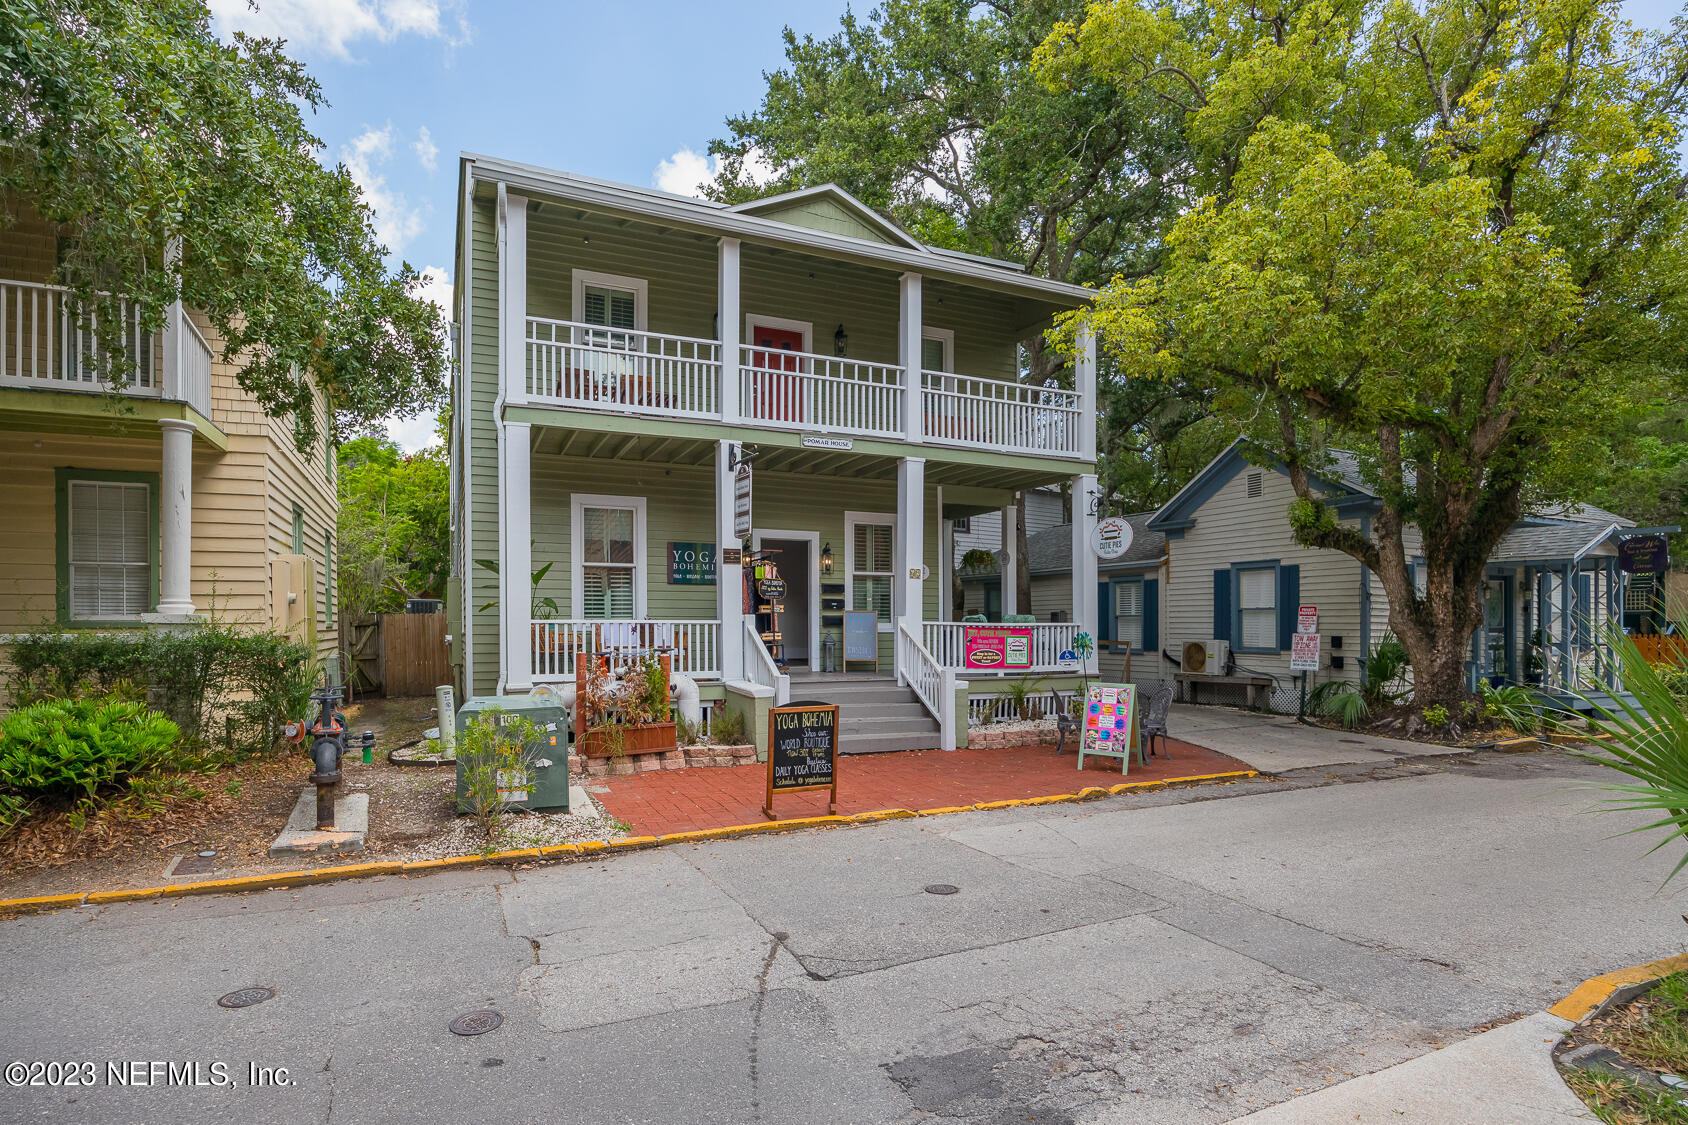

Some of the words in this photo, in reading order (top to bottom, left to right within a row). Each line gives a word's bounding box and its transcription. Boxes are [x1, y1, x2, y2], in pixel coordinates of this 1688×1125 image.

[830, 440, 850, 448] HOUSE
[1100, 541, 1111, 549] CUTIE
[776, 713, 799, 730] YOGA
[802, 711, 833, 728] BOHEMIA
[780, 738, 801, 751] WORLD
[803, 736, 831, 748] BOUTIQUE
[775, 766, 792, 777] DAILY
[793, 764, 810, 775] YOGA
[810, 763, 833, 774] CLASSES
